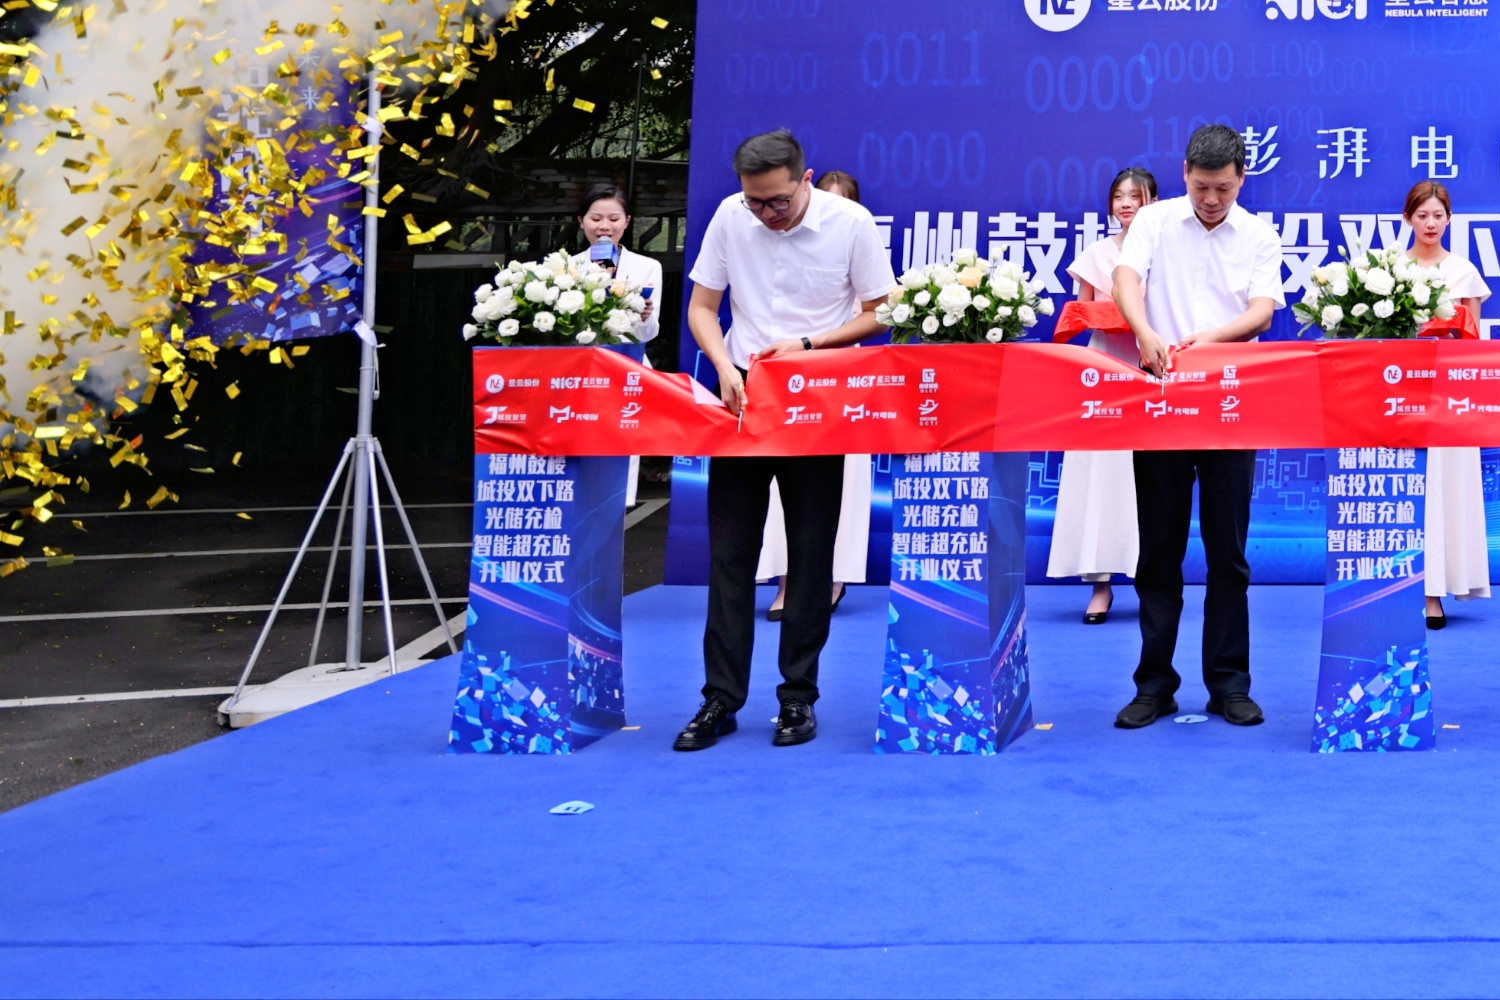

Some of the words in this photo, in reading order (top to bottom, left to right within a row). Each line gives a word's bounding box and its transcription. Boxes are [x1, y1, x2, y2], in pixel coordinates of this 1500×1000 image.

[1385, 8, 1425, 17] NEBULA
[1426, 8, 1489, 17] INTELLIGENT
[508, 378, 540, 387] 星云股份
[808, 378, 837, 387] 星云股份
[1104, 373, 1134, 381] 星云股份
[1406, 370, 1437, 378] 星云股份
[489, 454, 566, 475] 福州鼓楼
[904, 452, 980, 473] 福州鼓楼
[1338, 447, 1415, 469] 福州鼓楼
[477, 480, 573, 502] 城投双下路
[894, 478, 988, 500] 城投双下路
[1328, 474, 1424, 497] 城投双下路
[485, 507, 562, 530] 光储充检
[903, 505, 978, 528] 光储充检
[1337, 502, 1415, 524] 光储充检
[473, 534, 570, 557] 智能超充站
[893, 532, 987, 554] 智能超充站
[1327, 529, 1424, 552] 智能超充站
[479, 561, 564, 583] 开业仪式
[898, 559, 983, 581] 开业仪式
[1336, 556, 1415, 581] 开业仪式
